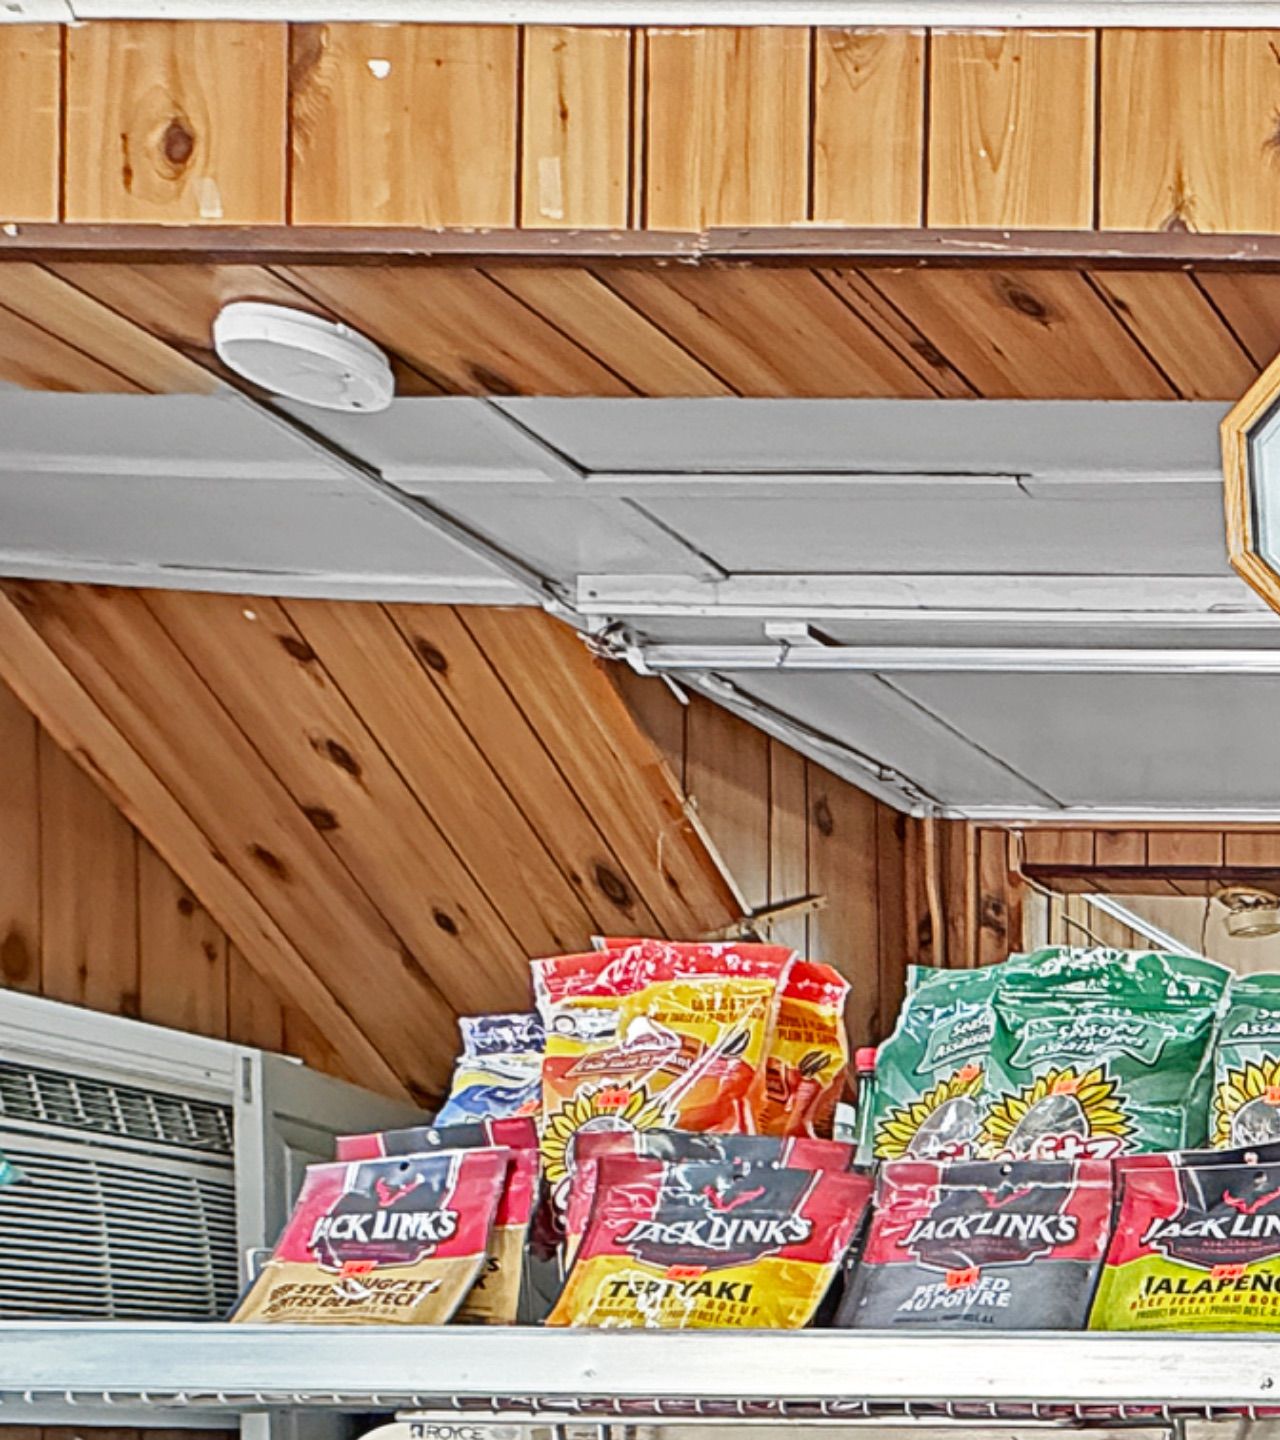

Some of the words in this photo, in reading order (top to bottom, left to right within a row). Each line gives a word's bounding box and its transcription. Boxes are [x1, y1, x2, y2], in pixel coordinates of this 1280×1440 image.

[899, 1214, 980, 1246] JACK
[1139, 1217, 1226, 1245] JACK
[608, 1280, 752, 1303] TERIYAKI
[426, 1426, 485, 1440] ROYCE
